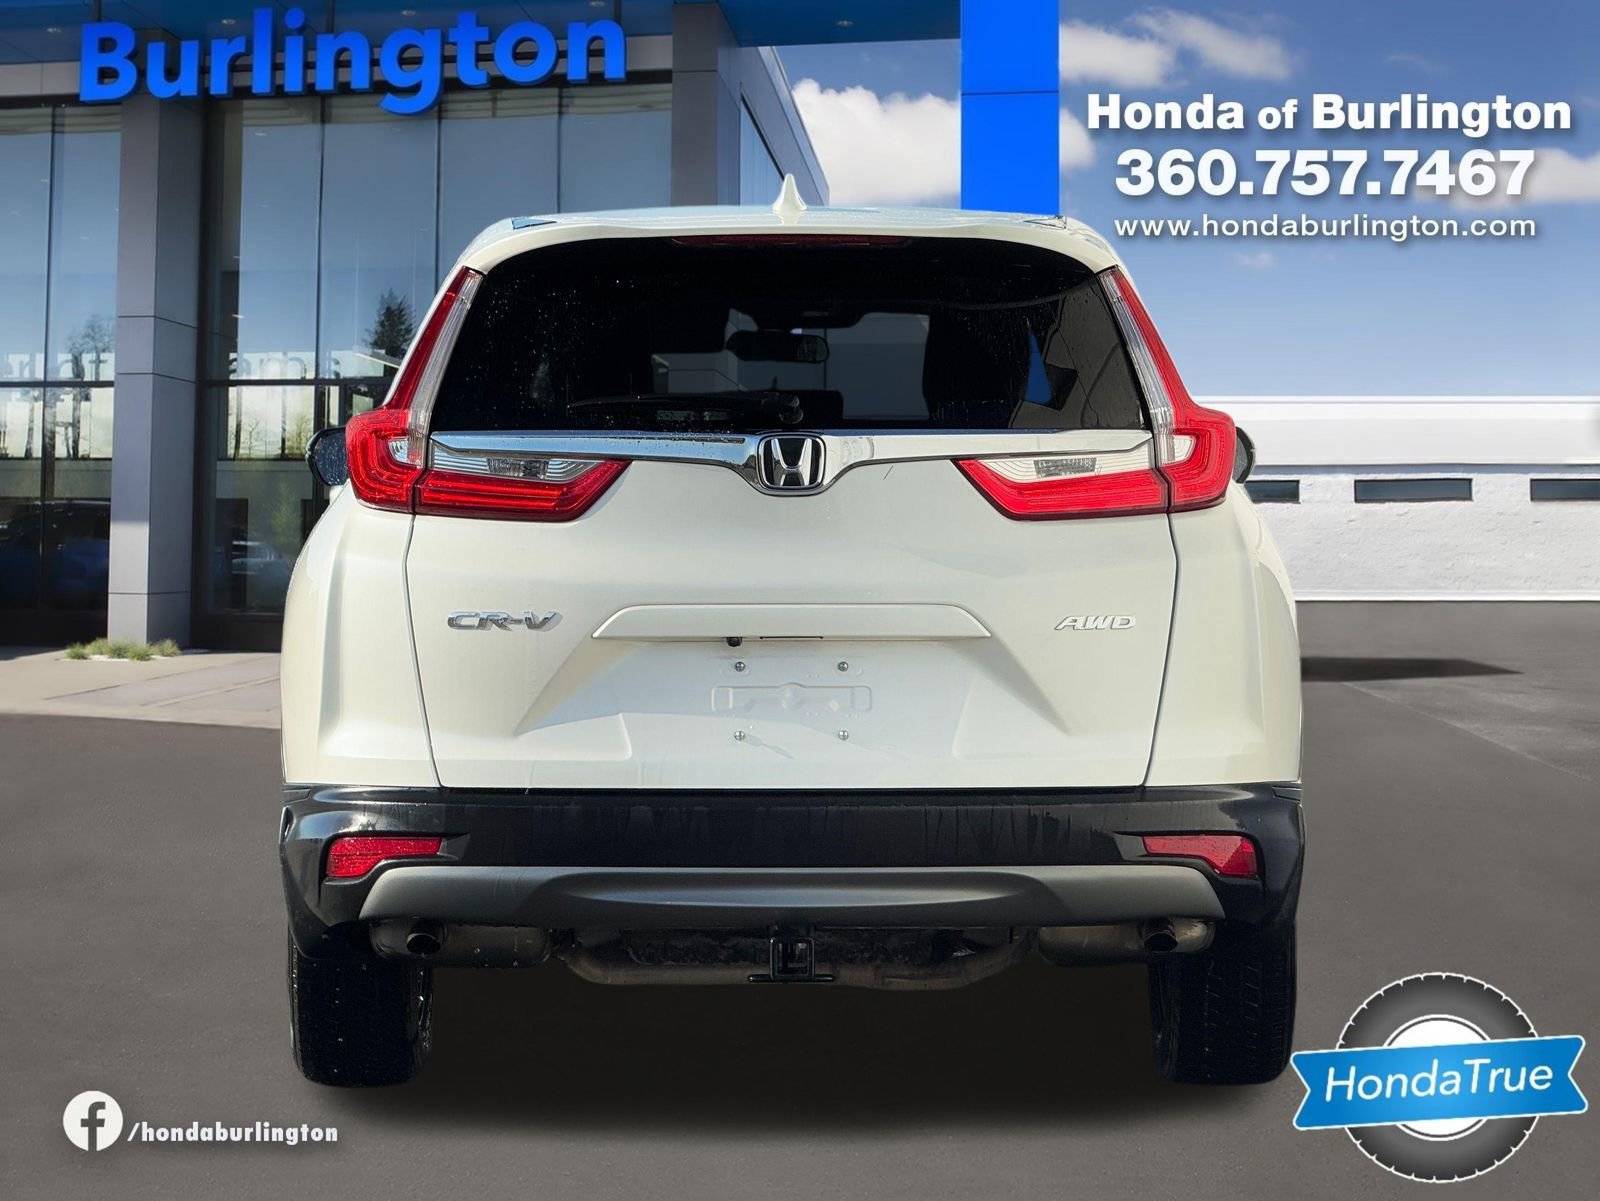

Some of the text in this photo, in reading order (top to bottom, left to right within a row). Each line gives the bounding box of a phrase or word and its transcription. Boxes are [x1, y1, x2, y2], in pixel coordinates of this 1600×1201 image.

[79, 7, 627, 115] Burlington
[447, 610, 562, 632] CR-V
[1054, 615, 1137, 631] AWD
